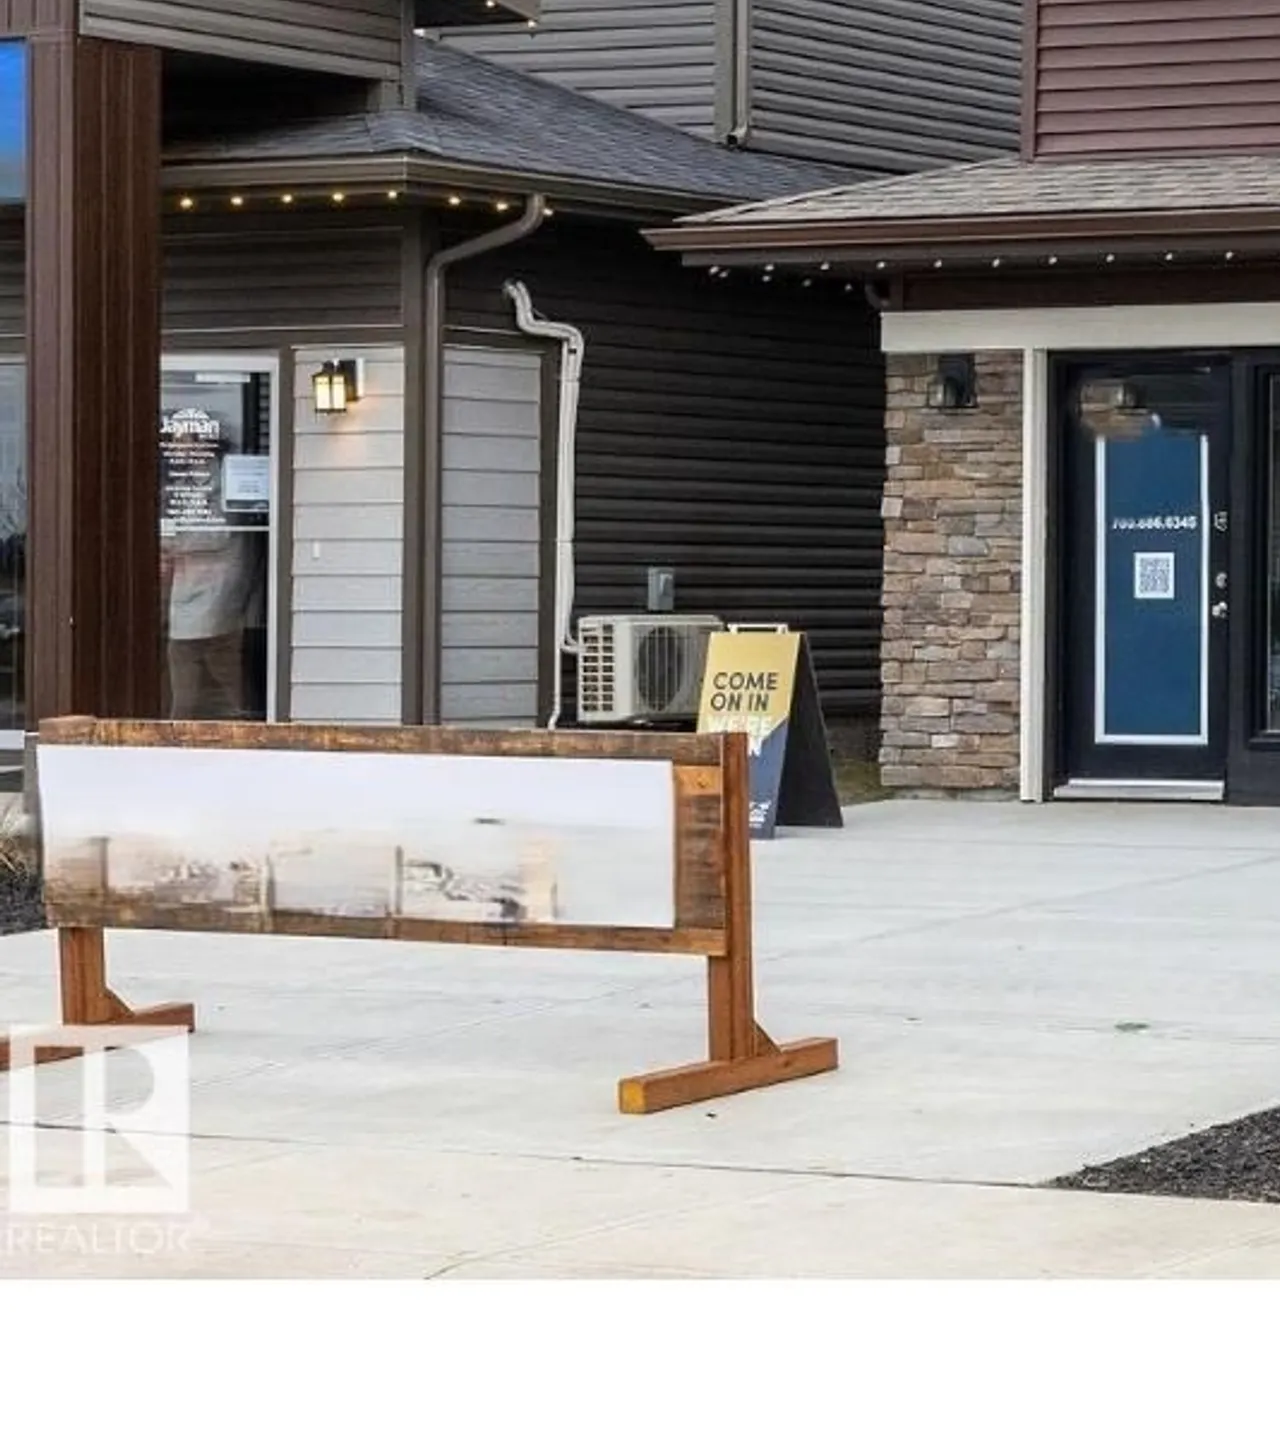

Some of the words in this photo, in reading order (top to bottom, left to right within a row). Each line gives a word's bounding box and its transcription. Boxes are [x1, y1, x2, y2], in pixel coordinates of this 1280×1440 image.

[713, 672, 778, 690] COME
[711, 692, 742, 711] ON
[748, 693, 769, 711] IN
